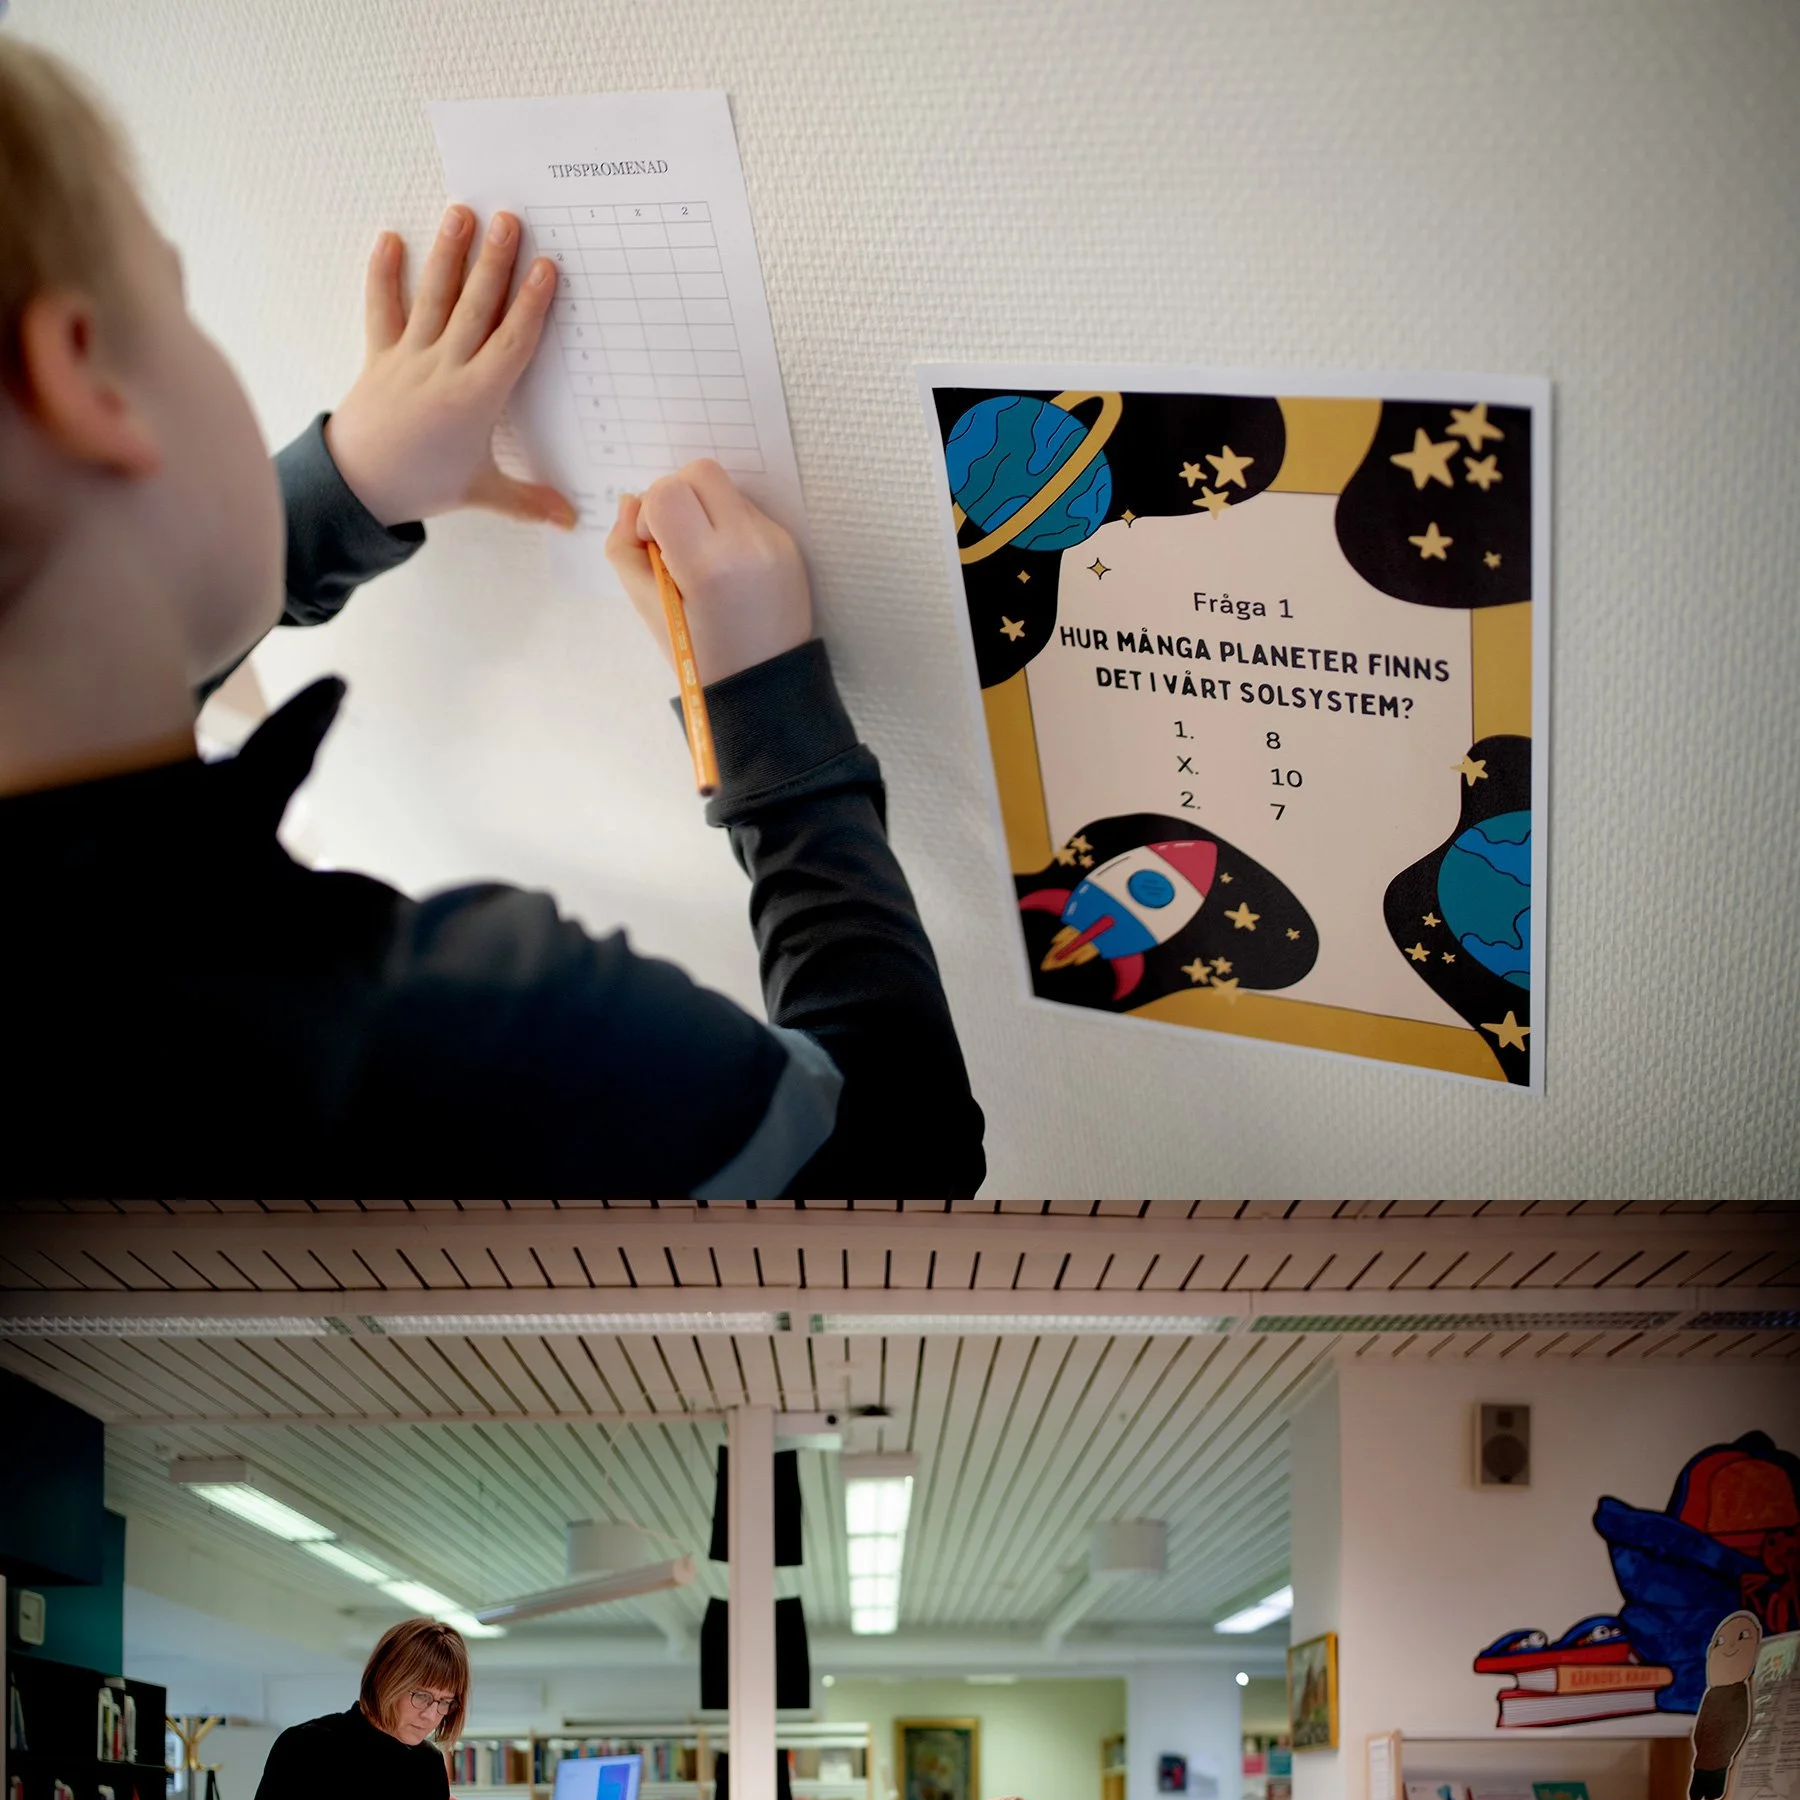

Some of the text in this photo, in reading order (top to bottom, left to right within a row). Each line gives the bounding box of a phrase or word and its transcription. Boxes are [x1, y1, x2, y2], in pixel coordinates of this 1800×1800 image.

[548, 159, 669, 179] TIPSPROMENAD
[681, 206, 689, 216] 2
[557, 252, 565, 262] 2
[1193, 592, 1295, 621] Fråga 1
[1060, 625, 1451, 683] HUR MÅNGA PLANETER FINNS
[1095, 667, 1415, 719] DET I VÅRT SOLSYSTEM?
[1173, 721, 1282, 750] 1. 8
[1176, 755, 1303, 789] X. 10
[1180, 791, 1286, 821] 2. 7
